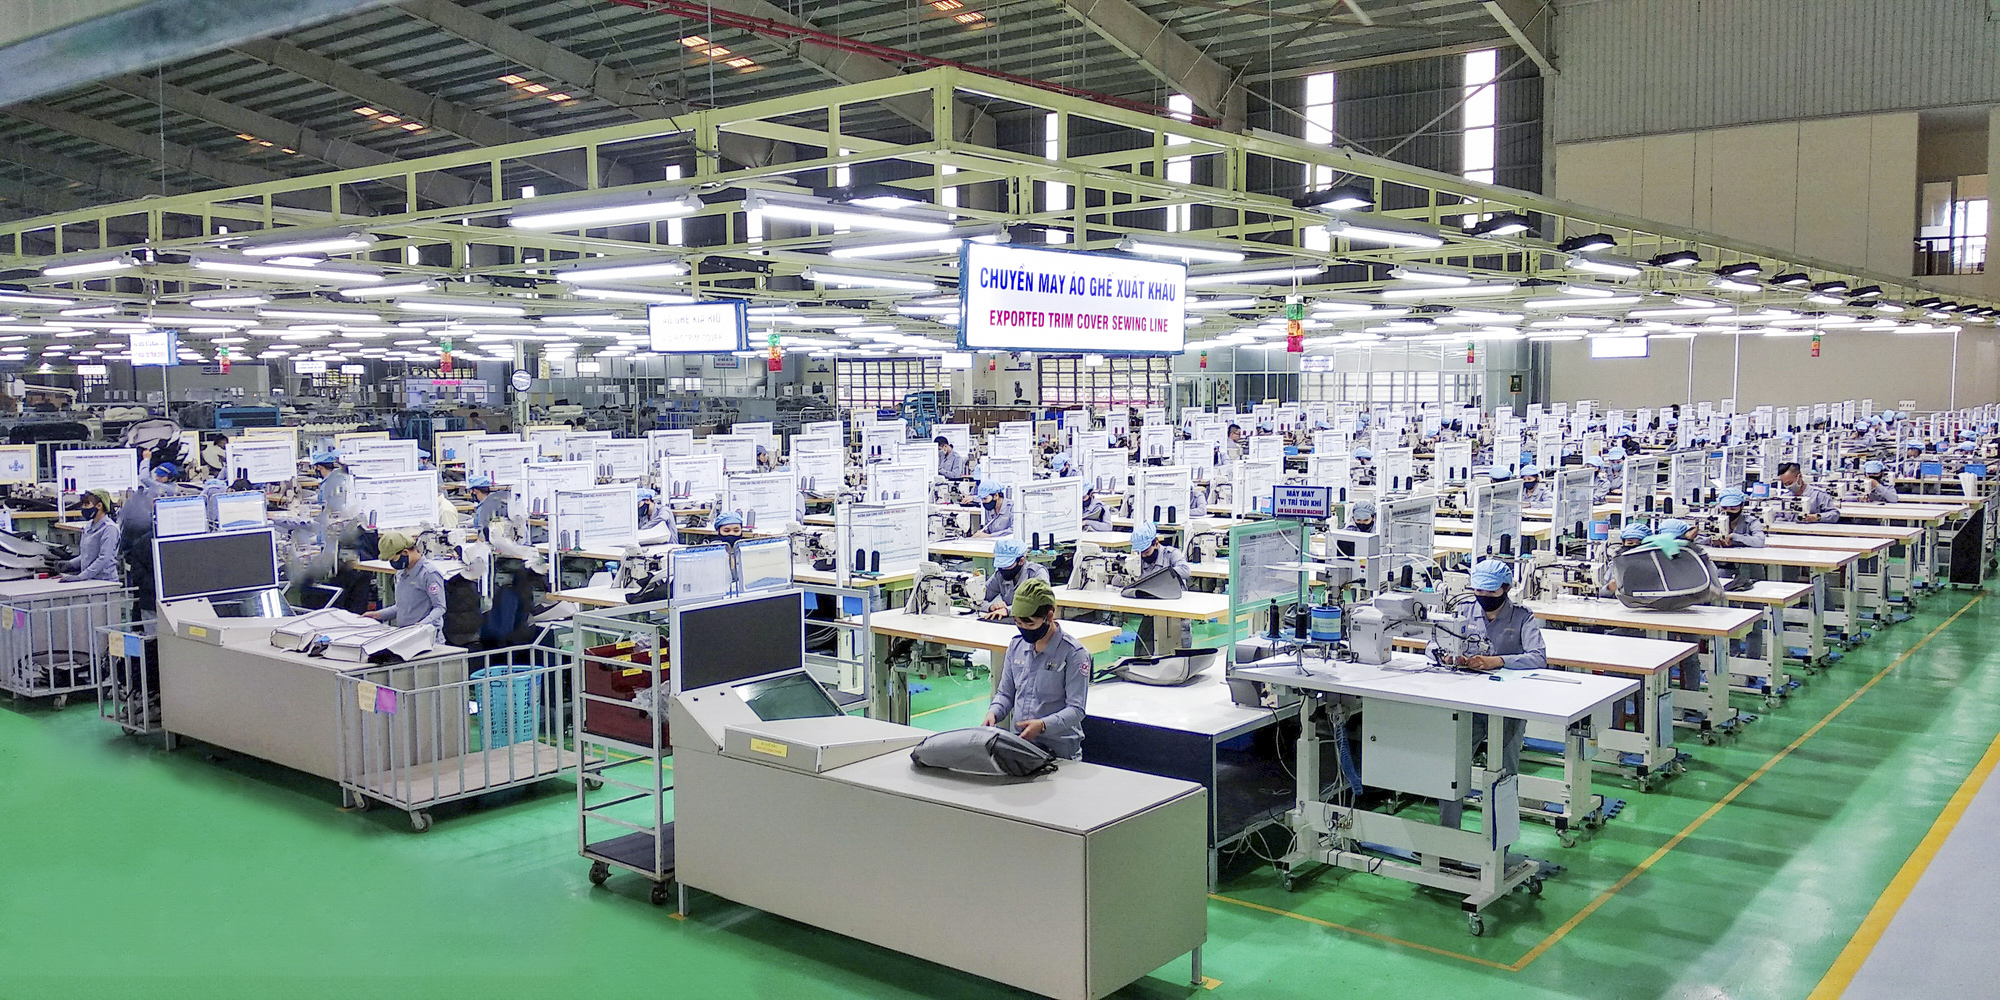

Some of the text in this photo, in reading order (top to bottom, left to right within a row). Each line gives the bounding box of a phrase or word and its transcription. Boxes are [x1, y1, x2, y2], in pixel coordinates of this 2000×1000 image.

[980, 263, 1034, 292] CHUYỀN
[1038, 273, 1065, 294] MAY
[1069, 270, 1086, 296] ÁO
[1090, 272, 1113, 298] GHẾ
[989, 310, 1169, 333] EXPORTED TRIM COVER SEWING LINE
[1286, 489, 1300, 497] MÁY
[1280, 498, 1322, 507] VỊ TRÍ TÚI KHÍ
